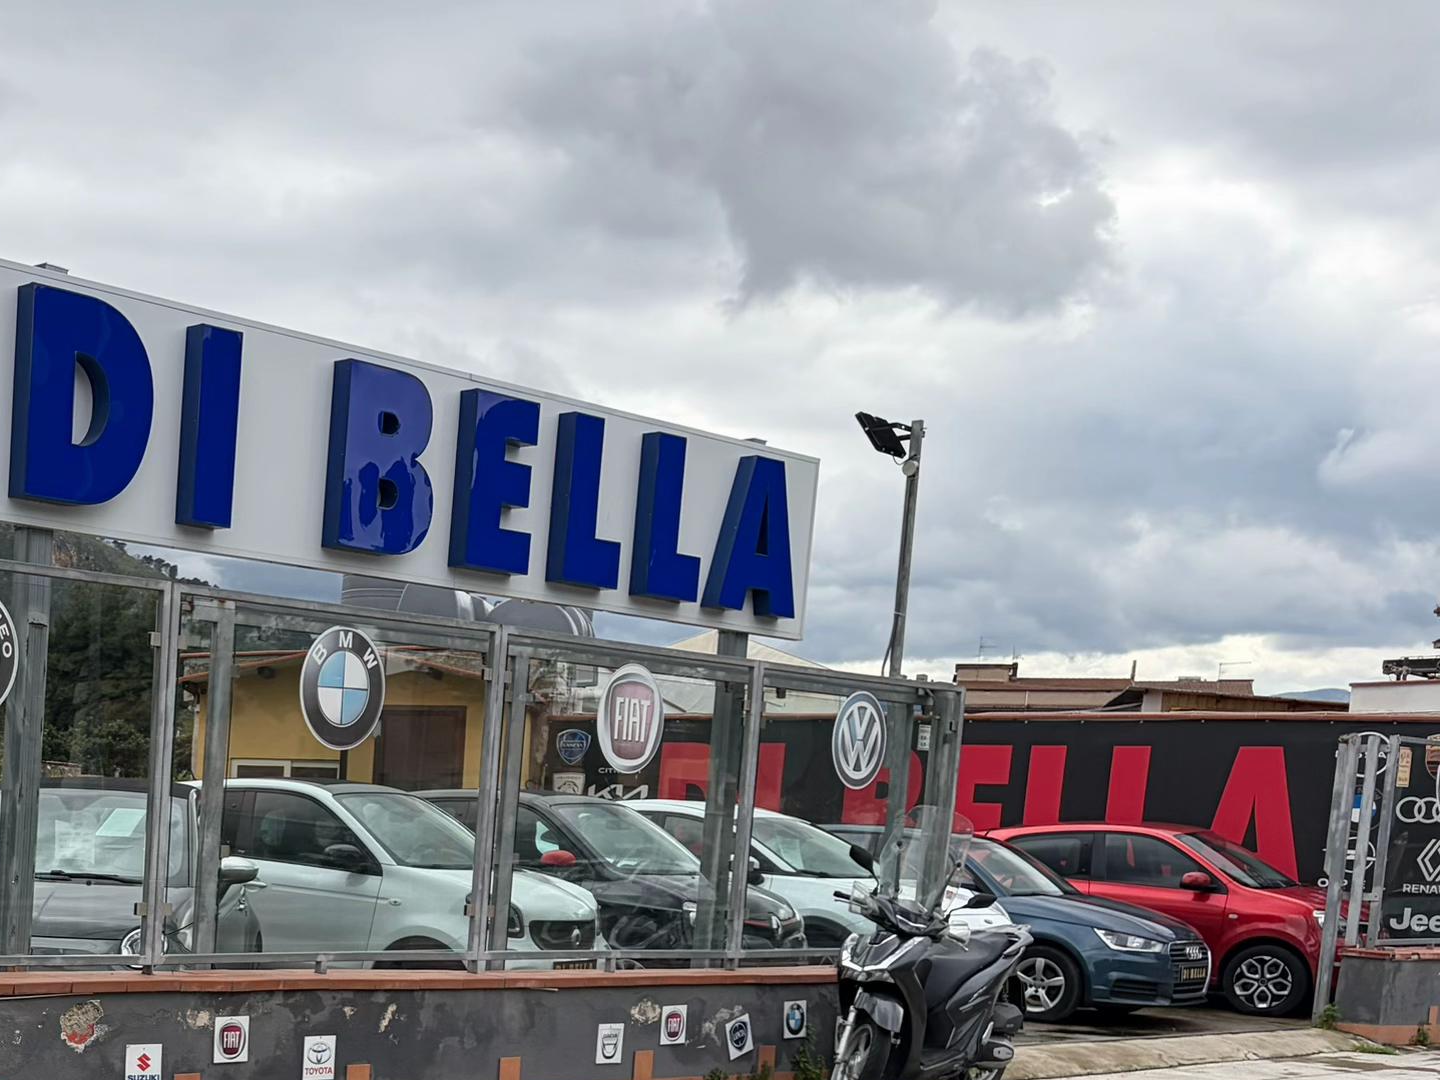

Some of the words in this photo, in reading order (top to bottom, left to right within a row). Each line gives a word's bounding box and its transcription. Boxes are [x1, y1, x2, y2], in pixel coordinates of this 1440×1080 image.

[8, 281, 244, 530] DI
[322, 357, 796, 620] BELLA
[311, 630, 379, 670] BMW
[613, 696, 651, 743] FIAT
[224, 1031, 241, 1049] FIAT
[667, 1017, 681, 1034] FIAT
[305, 1066, 333, 1076] TOYOTA
